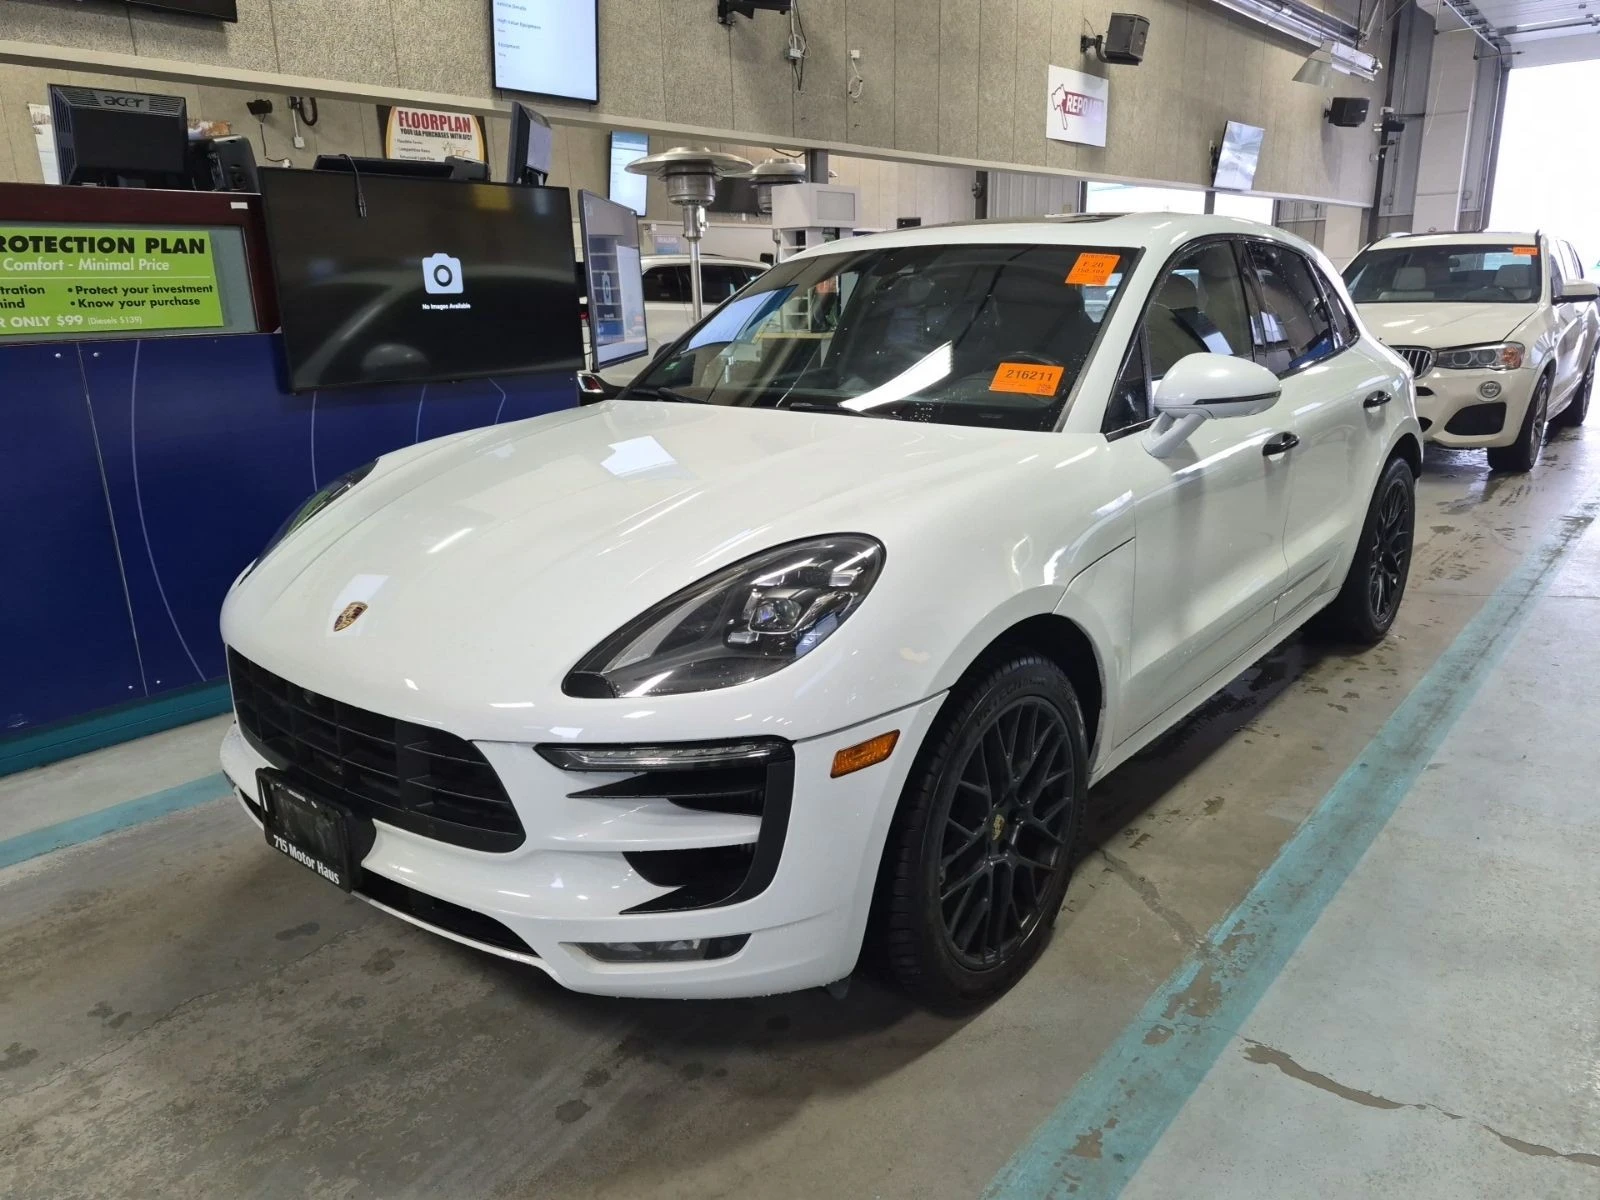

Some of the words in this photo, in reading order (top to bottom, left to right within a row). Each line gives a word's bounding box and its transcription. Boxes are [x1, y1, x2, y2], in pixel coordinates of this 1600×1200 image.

[104, 95, 144, 107] acer
[398, 110, 471, 133] FLOORPLAN
[400, 128, 414, 136] YOUR
[145, 238, 205, 254] PLAN
[3, 257, 64, 272] Comfort
[78, 258, 134, 271] Minimal
[138, 258, 170, 271] Price
[75, 285, 118, 295] Protect
[121, 286, 149, 296] your
[152, 284, 213, 293] investment
[78, 299, 115, 308] Know
[119, 300, 146, 309] your
[150, 297, 200, 308] purchase
[430, 303, 449, 311] Images
[11, 316, 50, 327] ONLY
[56, 315, 84, 326] $99
[1006, 369, 1053, 381] 216211
[273, 834, 288, 853] 715
[288, 843, 315, 870] Motor
[316, 860, 340, 885] Haus
